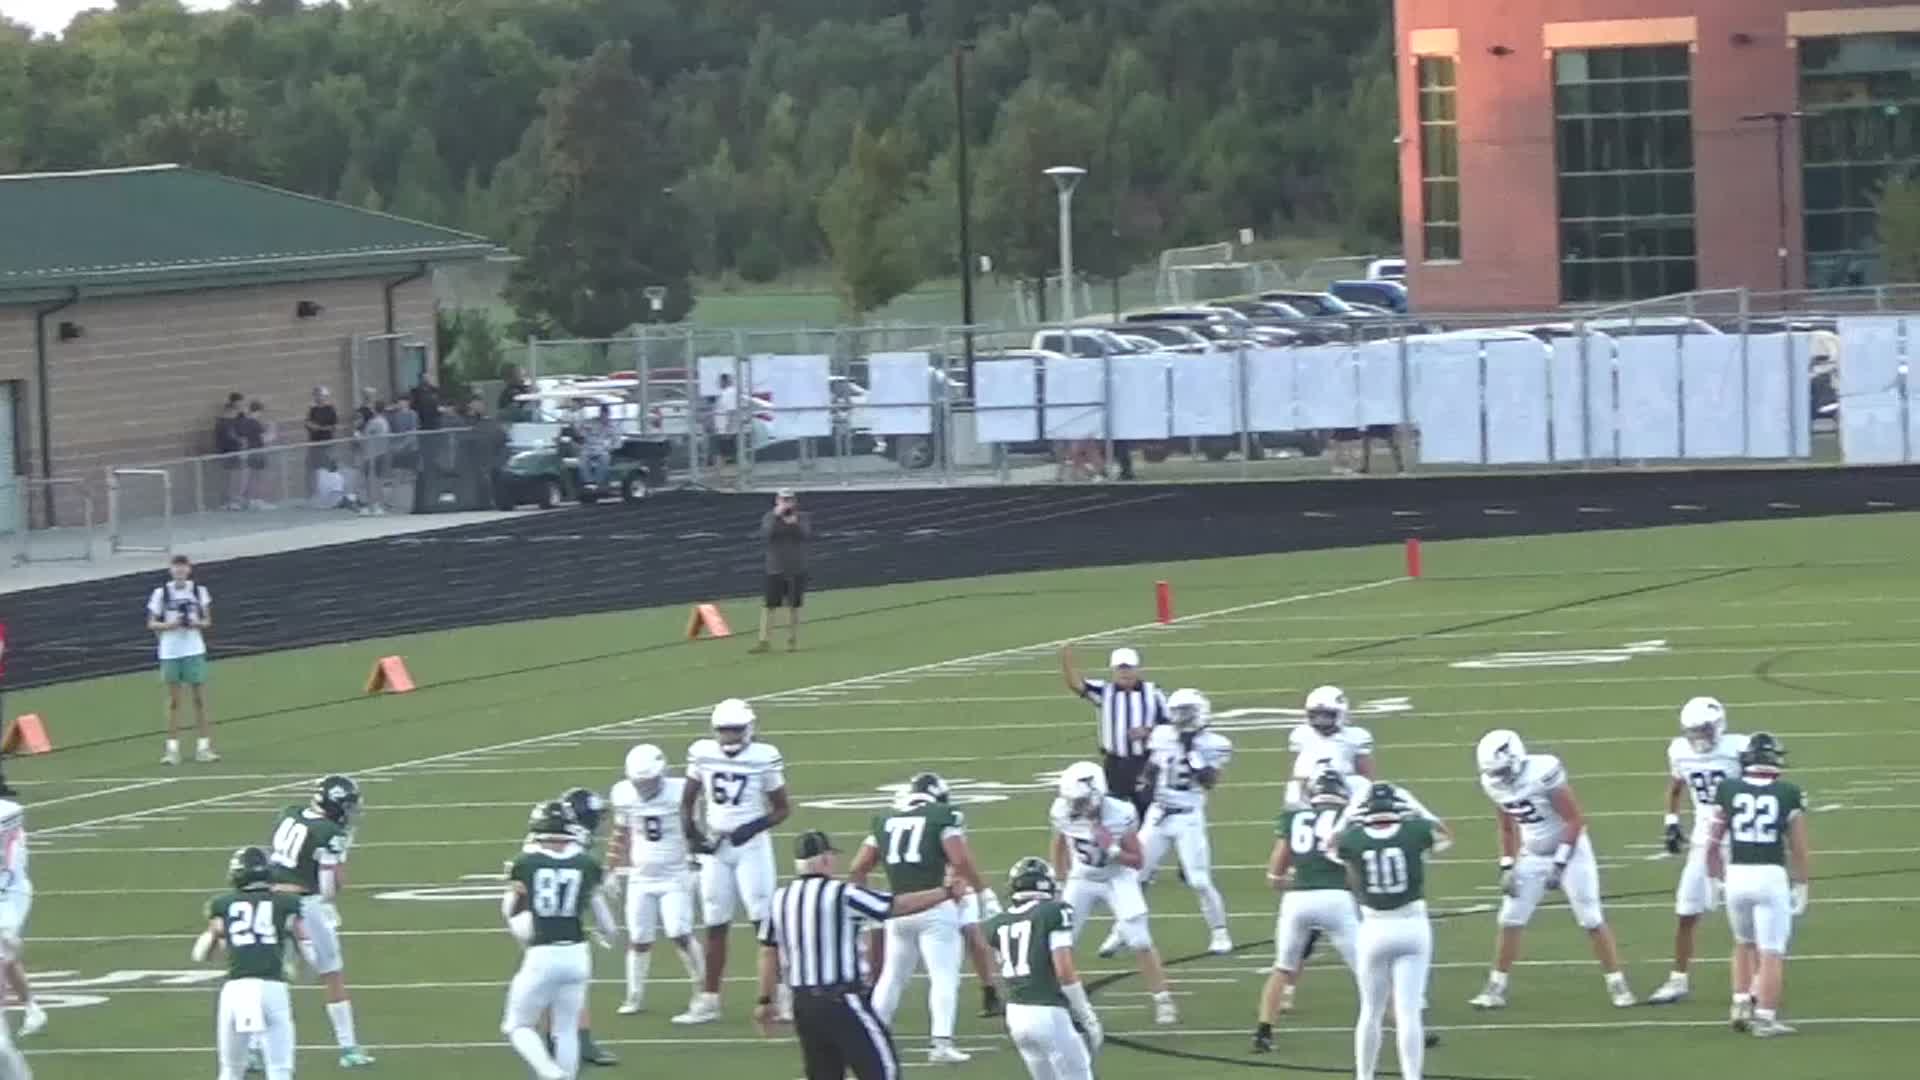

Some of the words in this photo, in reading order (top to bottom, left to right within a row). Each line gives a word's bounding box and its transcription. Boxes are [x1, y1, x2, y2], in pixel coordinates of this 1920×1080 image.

[712, 772, 748, 806] 67
[646, 816, 662, 841] 8
[884, 816, 927, 864] 77
[1732, 792, 1779, 842] 22
[270, 817, 308, 868] 40
[533, 868, 583, 917] 87
[1361, 847, 1408, 893] 10
[228, 900, 279, 947] 24
[997, 919, 1032, 978] 17
